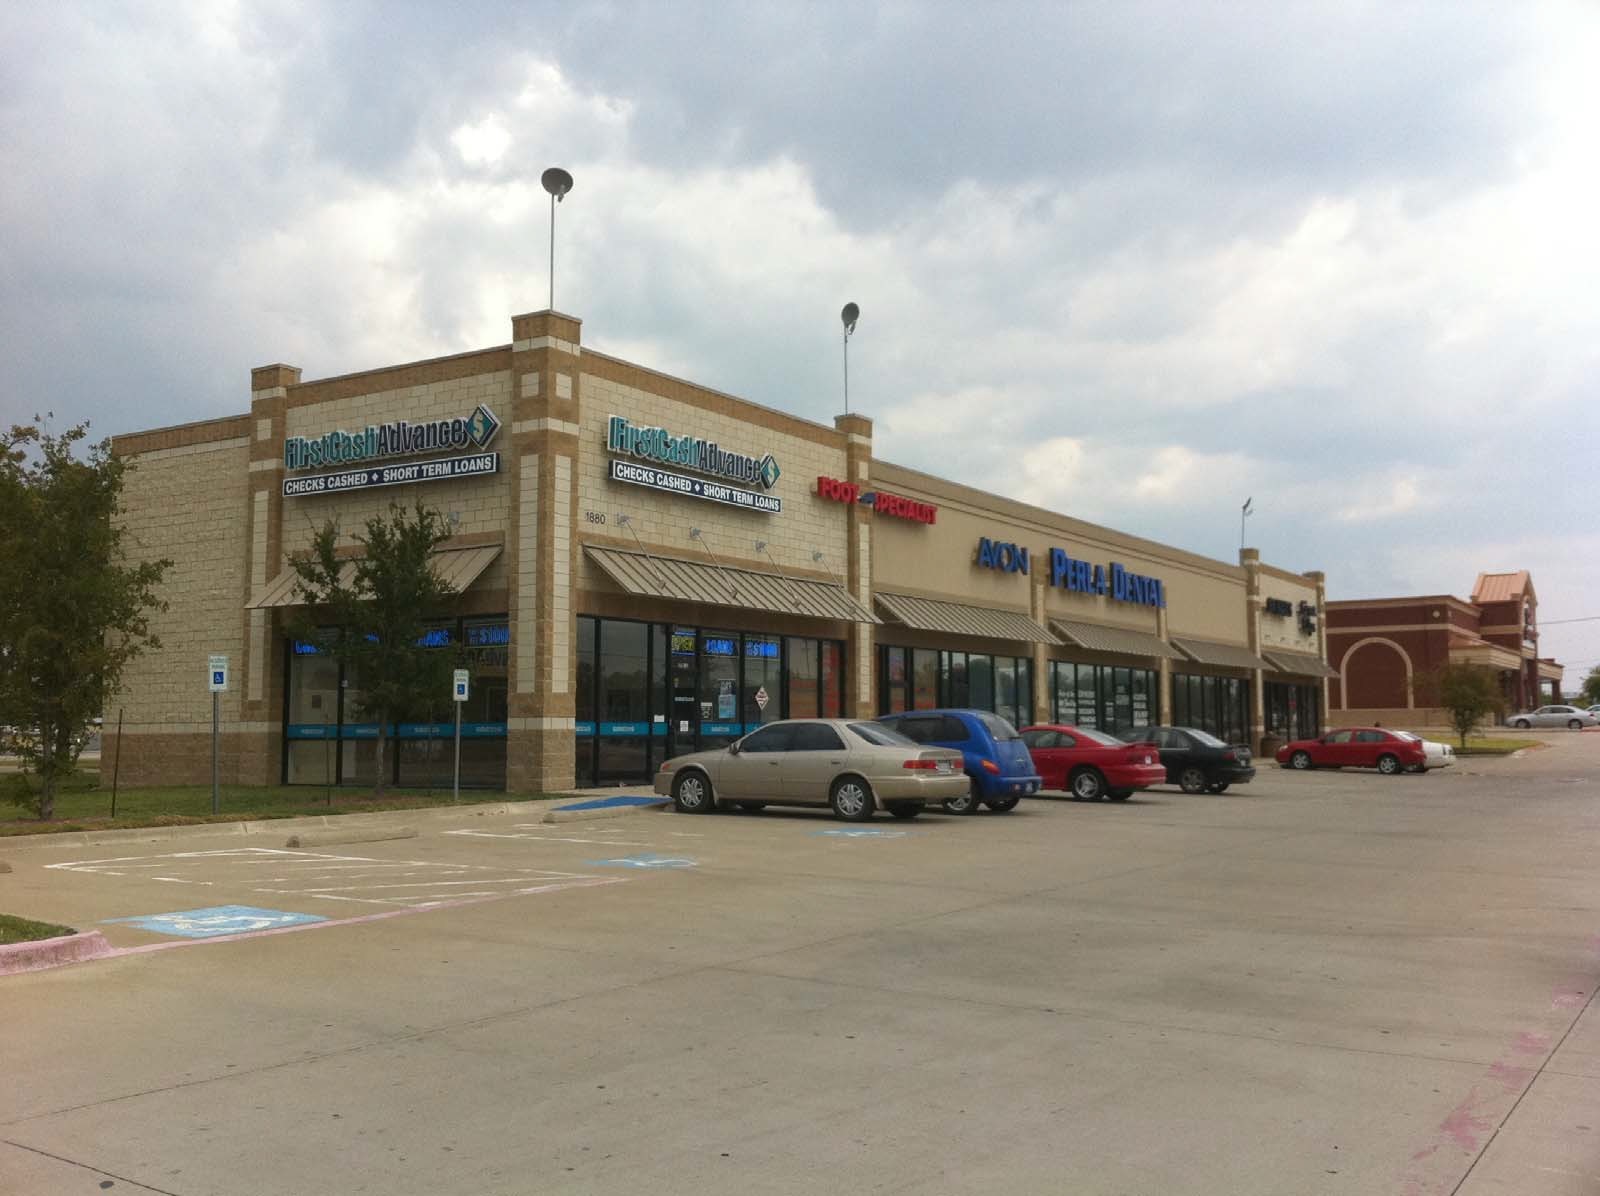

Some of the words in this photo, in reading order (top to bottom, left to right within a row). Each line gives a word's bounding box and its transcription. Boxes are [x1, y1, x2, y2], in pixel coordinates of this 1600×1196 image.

[285, 477, 325, 494] CHECKS
[327, 473, 368, 490] CASHED
[383, 466, 418, 483] SHORT
[421, 462, 451, 478] TERM
[454, 457, 492, 473] LOANS
[616, 464, 655, 484] CHECKS
[656, 473, 692, 491] CASHED
[703, 483, 732, 501] SHORT
[732, 490, 754, 505] TERM
[755, 495, 780, 512] LOANS
[817, 476, 859, 504] FOOT
[586, 511, 606, 525] 1880
[978, 536, 1029, 575] AVON
